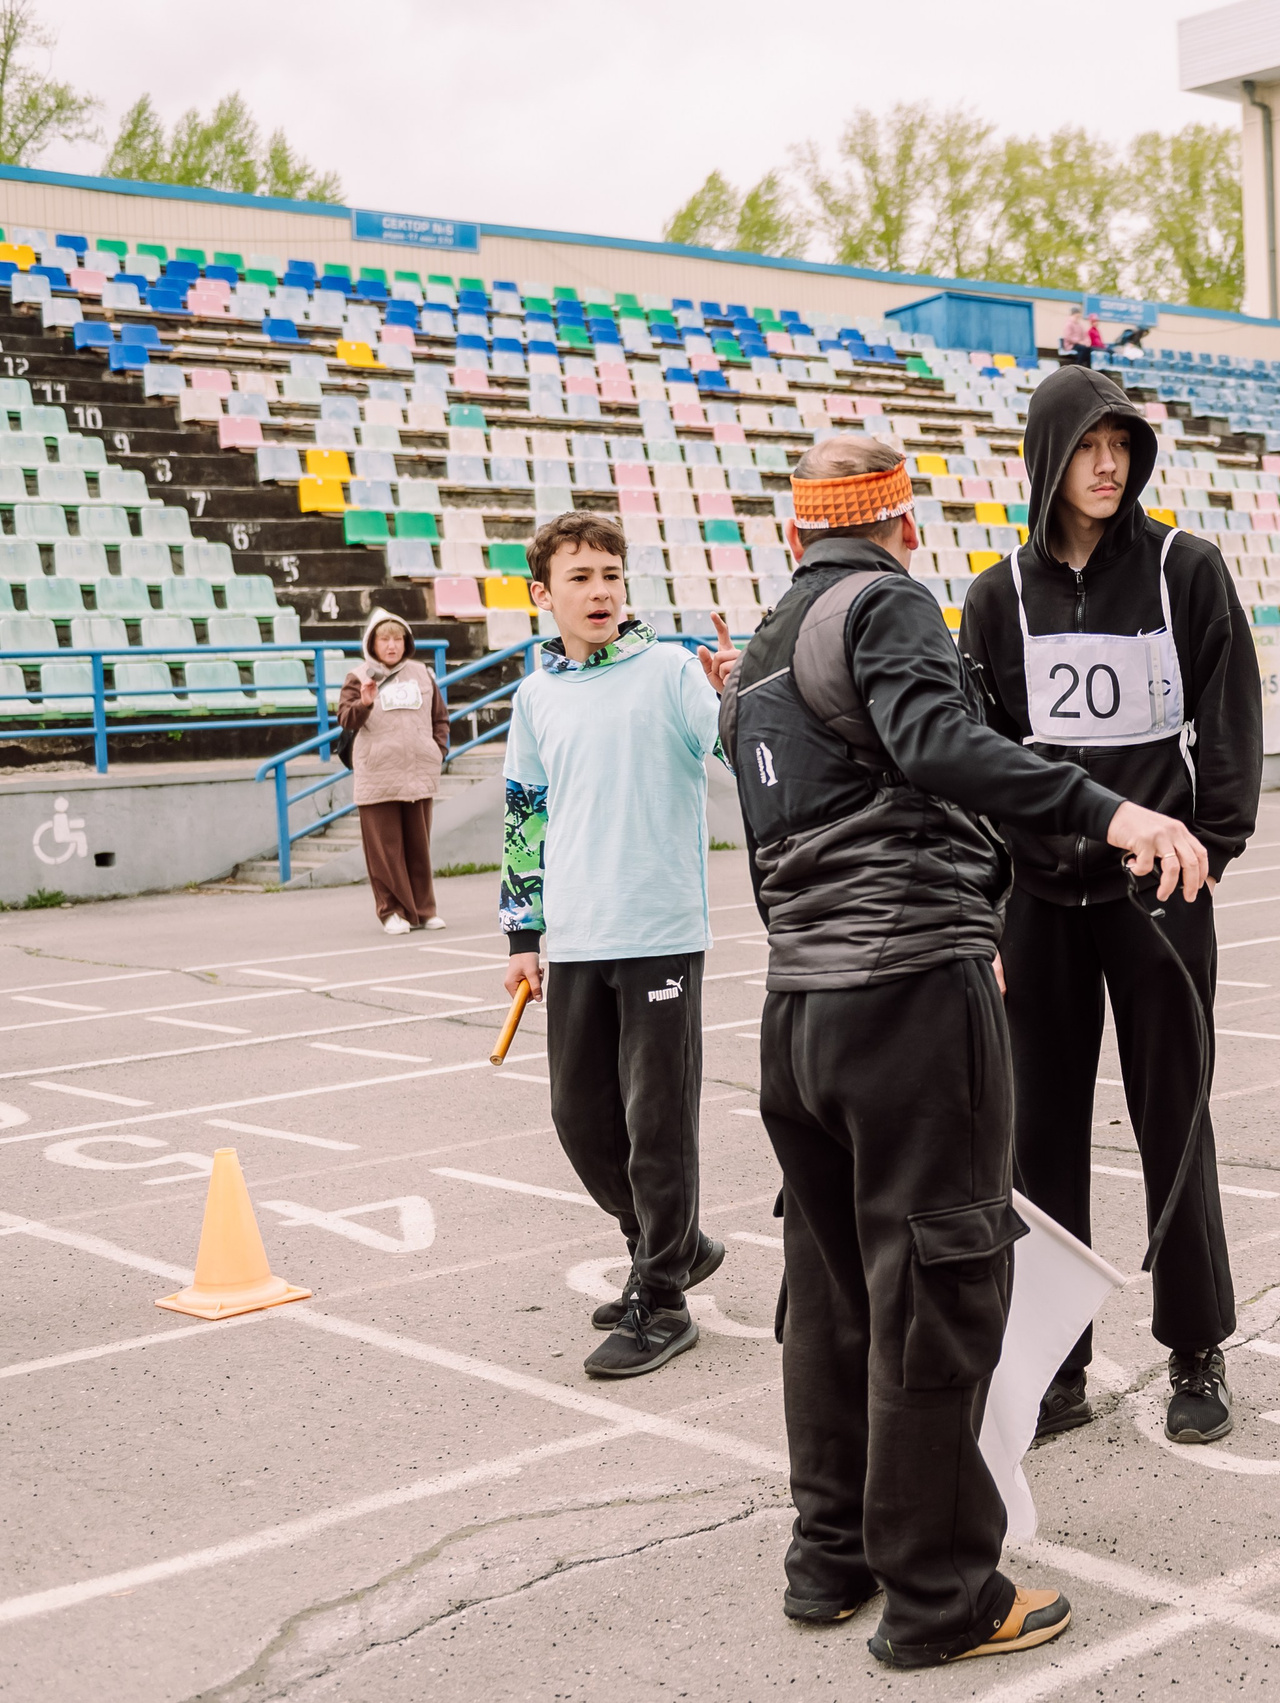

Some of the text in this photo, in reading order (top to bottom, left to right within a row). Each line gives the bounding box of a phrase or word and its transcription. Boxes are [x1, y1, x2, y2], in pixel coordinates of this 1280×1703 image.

[382, 217, 430, 232] СЕКТОР
[3, 356, 30, 377] 12
[73, 406, 103, 429] 10
[113, 432, 131, 455] 9
[191, 491, 207, 517] 7
[232, 522, 250, 551] 6
[321, 591, 340, 620] 4
[1049, 663, 1121, 719] 20
[648, 986, 679, 1003] PUMA
[257, 1194, 437, 1254] 4
